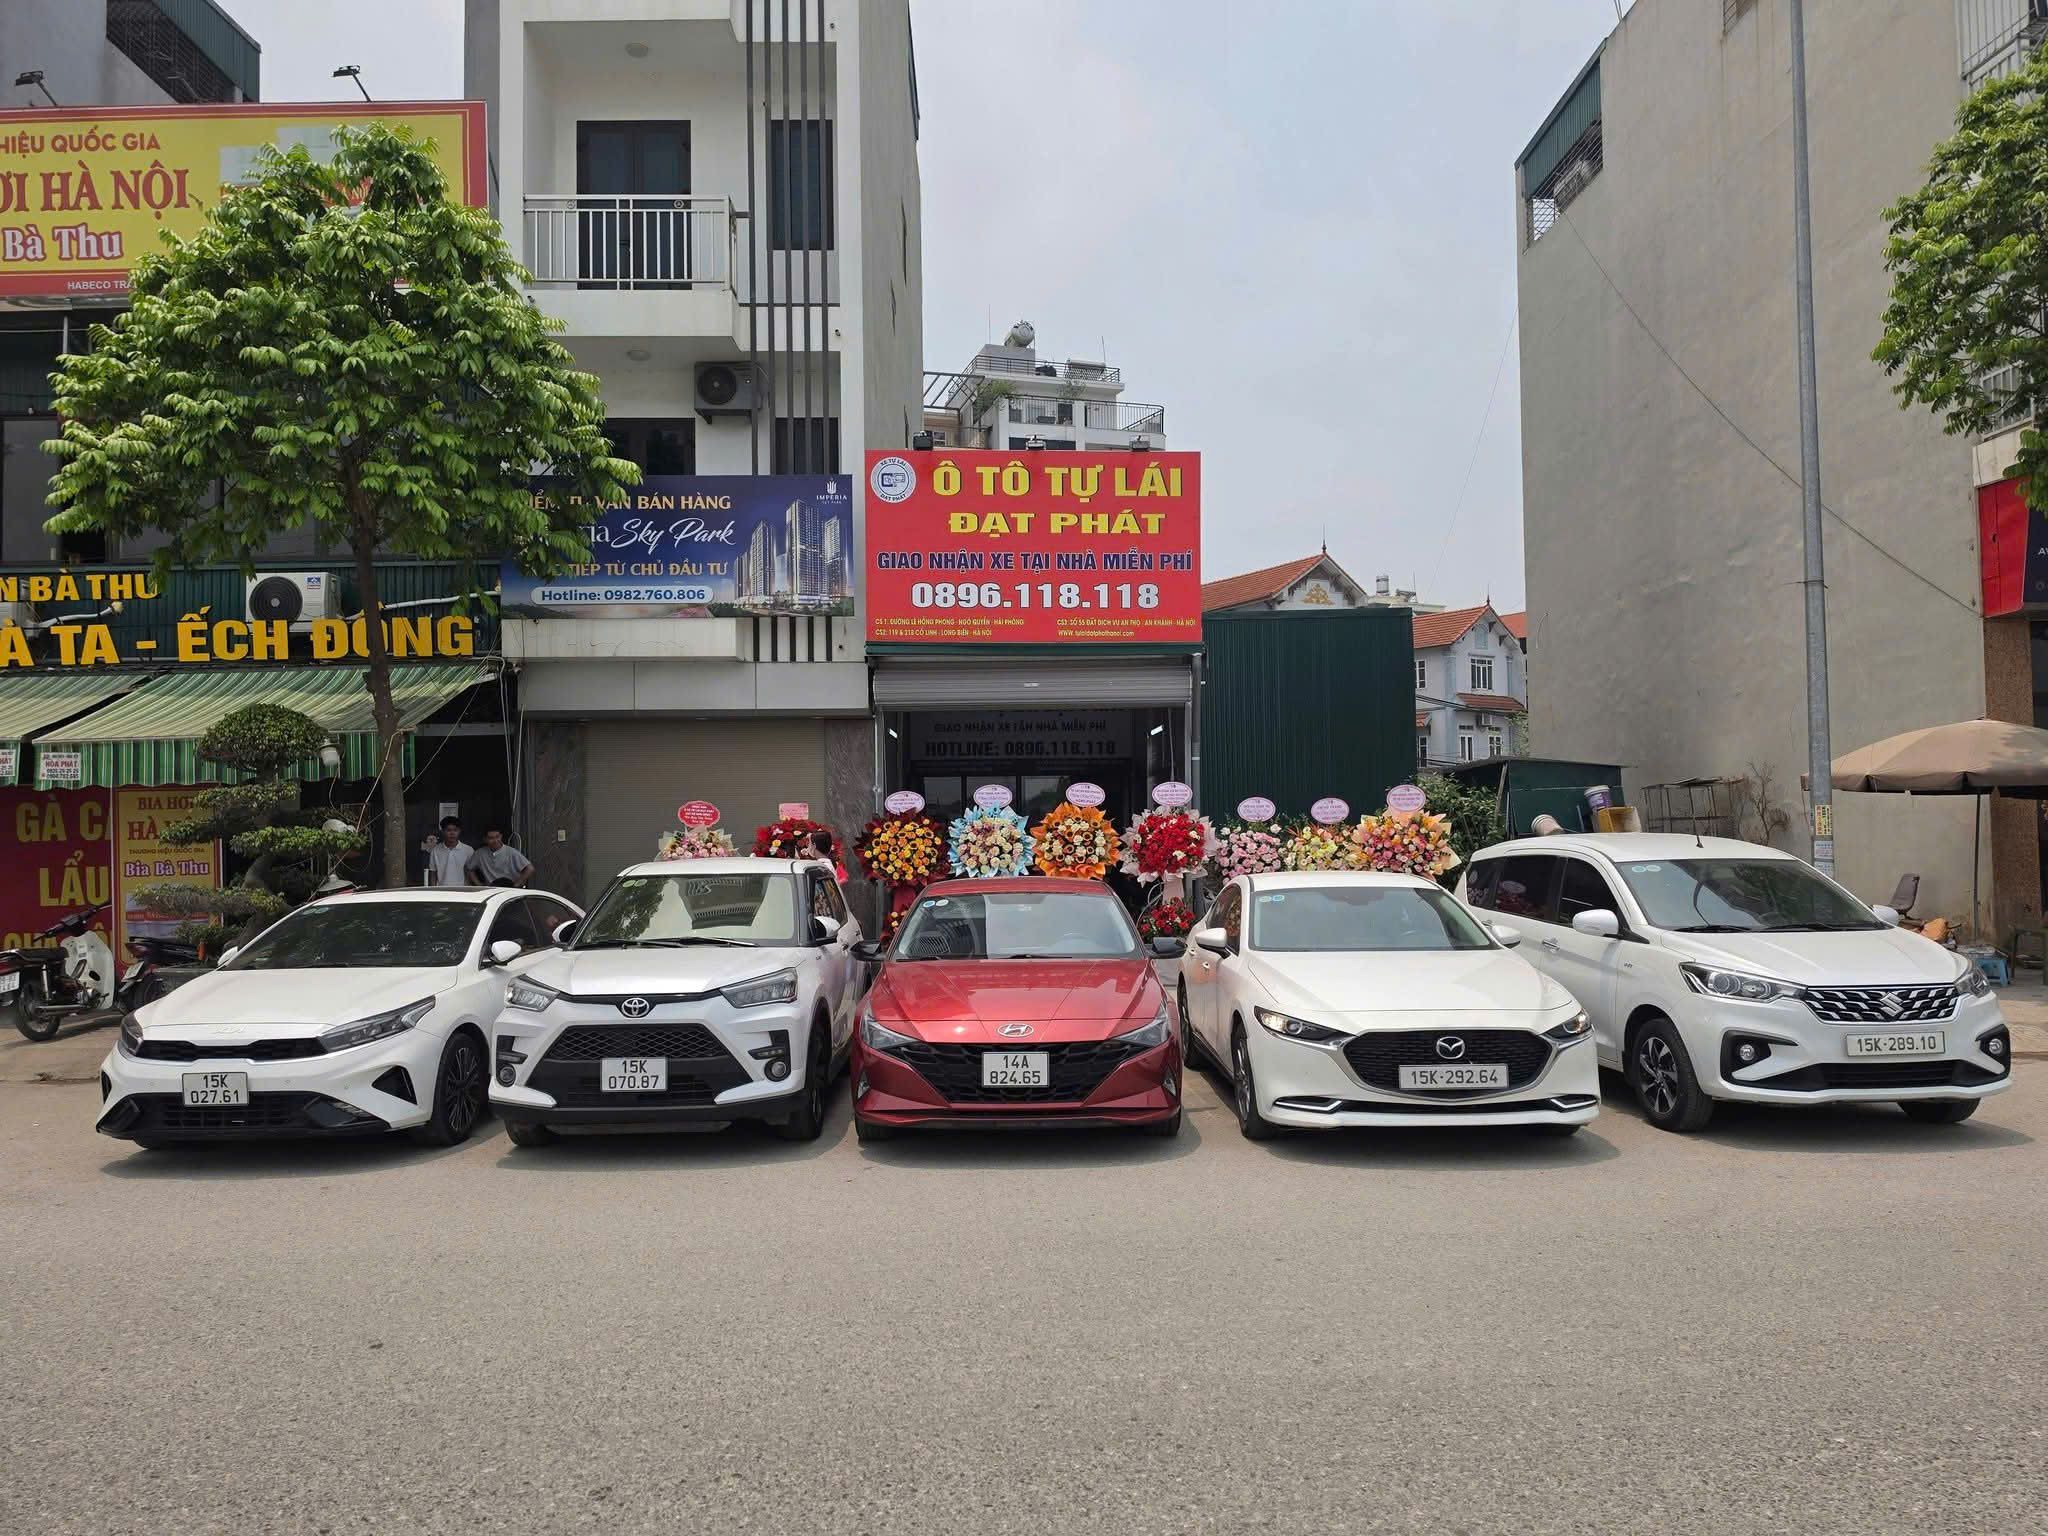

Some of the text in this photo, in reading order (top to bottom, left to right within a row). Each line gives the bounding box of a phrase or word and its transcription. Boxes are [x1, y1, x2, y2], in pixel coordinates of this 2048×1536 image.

[51, 125, 117, 153] QUỐC
[122, 132, 161, 151] GIA
[40, 159, 103, 212] HÀ
[110, 159, 190, 220] NỘI
[2, 222, 124, 262] Bà Thu
[67, 281, 111, 290] HABECO
[933, 459, 1183, 503] Ô TÔ TỰ LÁI
[637, 492, 674, 510] BÁN
[680, 492, 731, 510] HÀNG
[610, 517, 664, 555] Sky
[669, 517, 737, 548] Park
[949, 508, 1167, 538] ĐẠT PHÁT
[605, 559, 626, 576] TỪ
[630, 558, 664, 576] CHỦ
[669, 557, 703, 576] ĐẦU
[707, 561, 728, 576] TƯ
[877, 547, 1193, 574] GIAO NHẬN XE TẠI NHÀ MIỄN PHÍ
[29, 568, 81, 602] BÀ
[85, 572, 160, 600] THU
[541, 589, 706, 601] Hotline: 0982.760.806
[911, 582, 1160, 609] 0896.118.118
[50, 624, 121, 666] TA
[176, 604, 289, 663] ẾCH
[15, 794, 68, 843] GÀ
[127, 815, 161, 841] HÀ
[39, 849, 110, 907] LẨU
[124, 859, 210, 877] Bia Bà Thu
[621, 1059, 648, 1074] 15K
[1003, 1055, 1029, 1069] 14A
[203, 1074, 229, 1089] 15K
[608, 1075, 659, 1089] 070.87
[990, 1070, 1041, 1085] 824.65
[190, 1089, 240, 1104] 027.61
